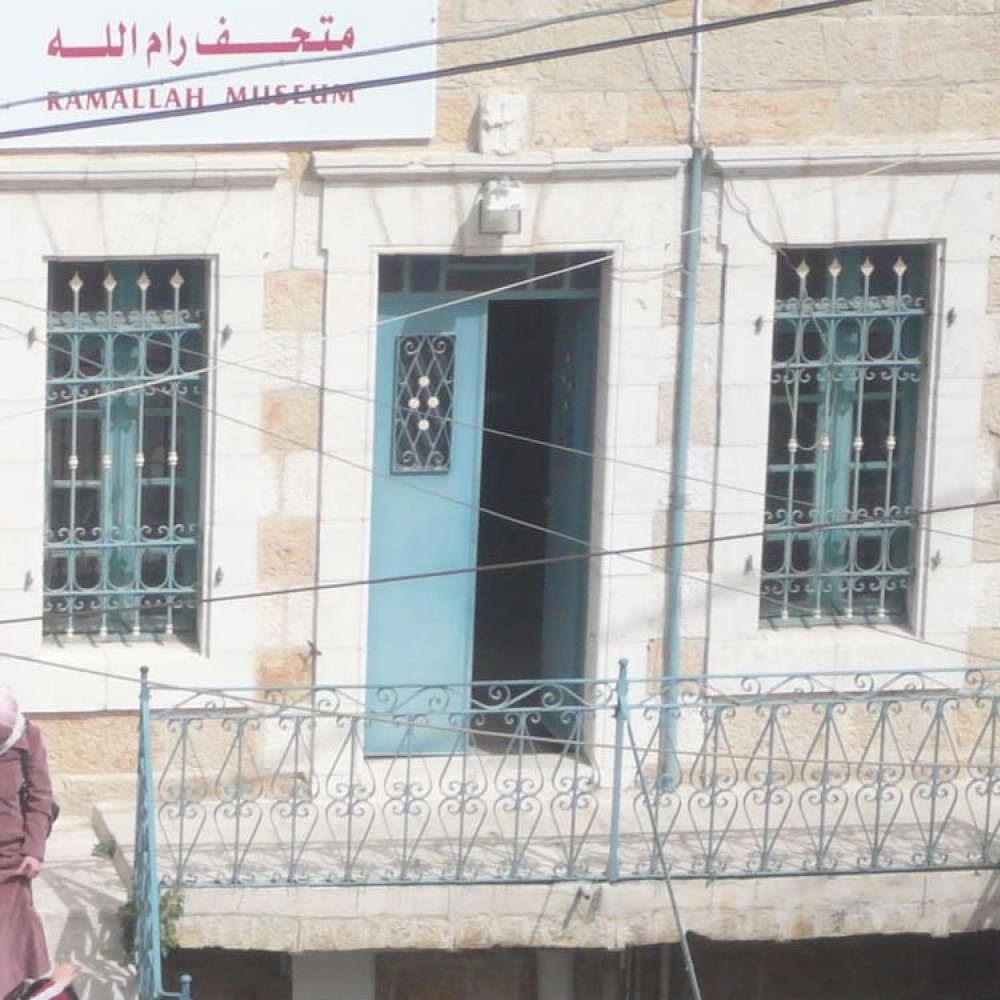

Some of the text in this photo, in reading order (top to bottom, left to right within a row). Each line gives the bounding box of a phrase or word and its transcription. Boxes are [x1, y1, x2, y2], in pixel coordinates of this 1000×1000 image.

[46, 16, 355, 68] متحف رام الله
[46, 84, 356, 111] RAMALLAH MUSEUM
